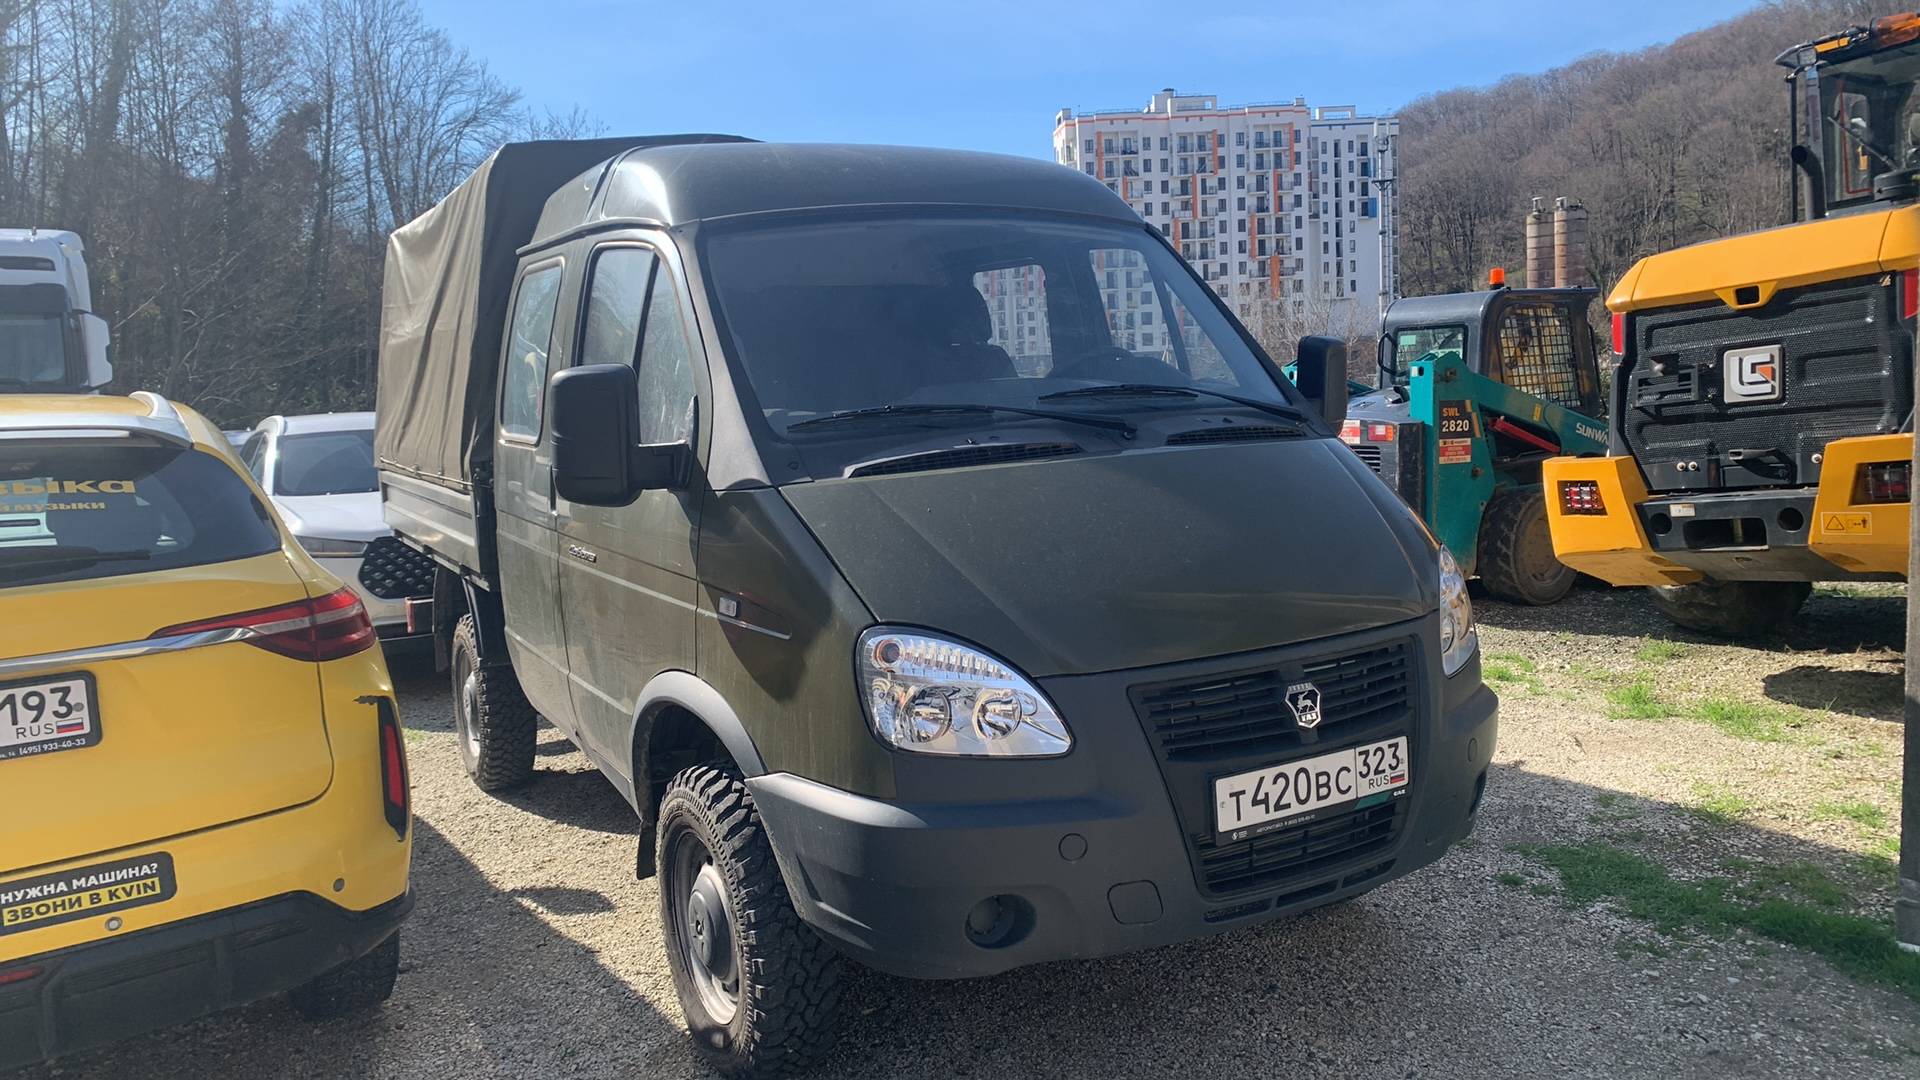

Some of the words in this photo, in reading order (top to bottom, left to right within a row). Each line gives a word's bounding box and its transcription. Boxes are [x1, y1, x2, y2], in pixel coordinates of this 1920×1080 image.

[1442, 407, 1460, 417] SWL
[1441, 419, 1470, 432] 2820
[0, 686, 73, 726] 193
[16, 723, 54, 739] RUS
[43, 738, 86, 751] 933-40-33
[1358, 742, 1400, 778] 323
[1368, 775, 1389, 789] RUS
[0, 882, 68, 904] НУЖНА
[72, 863, 158, 890] МАШИНА?
[7, 896, 82, 923] ЗВОНИ
[89, 892, 102, 905] В
[108, 880, 156, 901] KVIN
